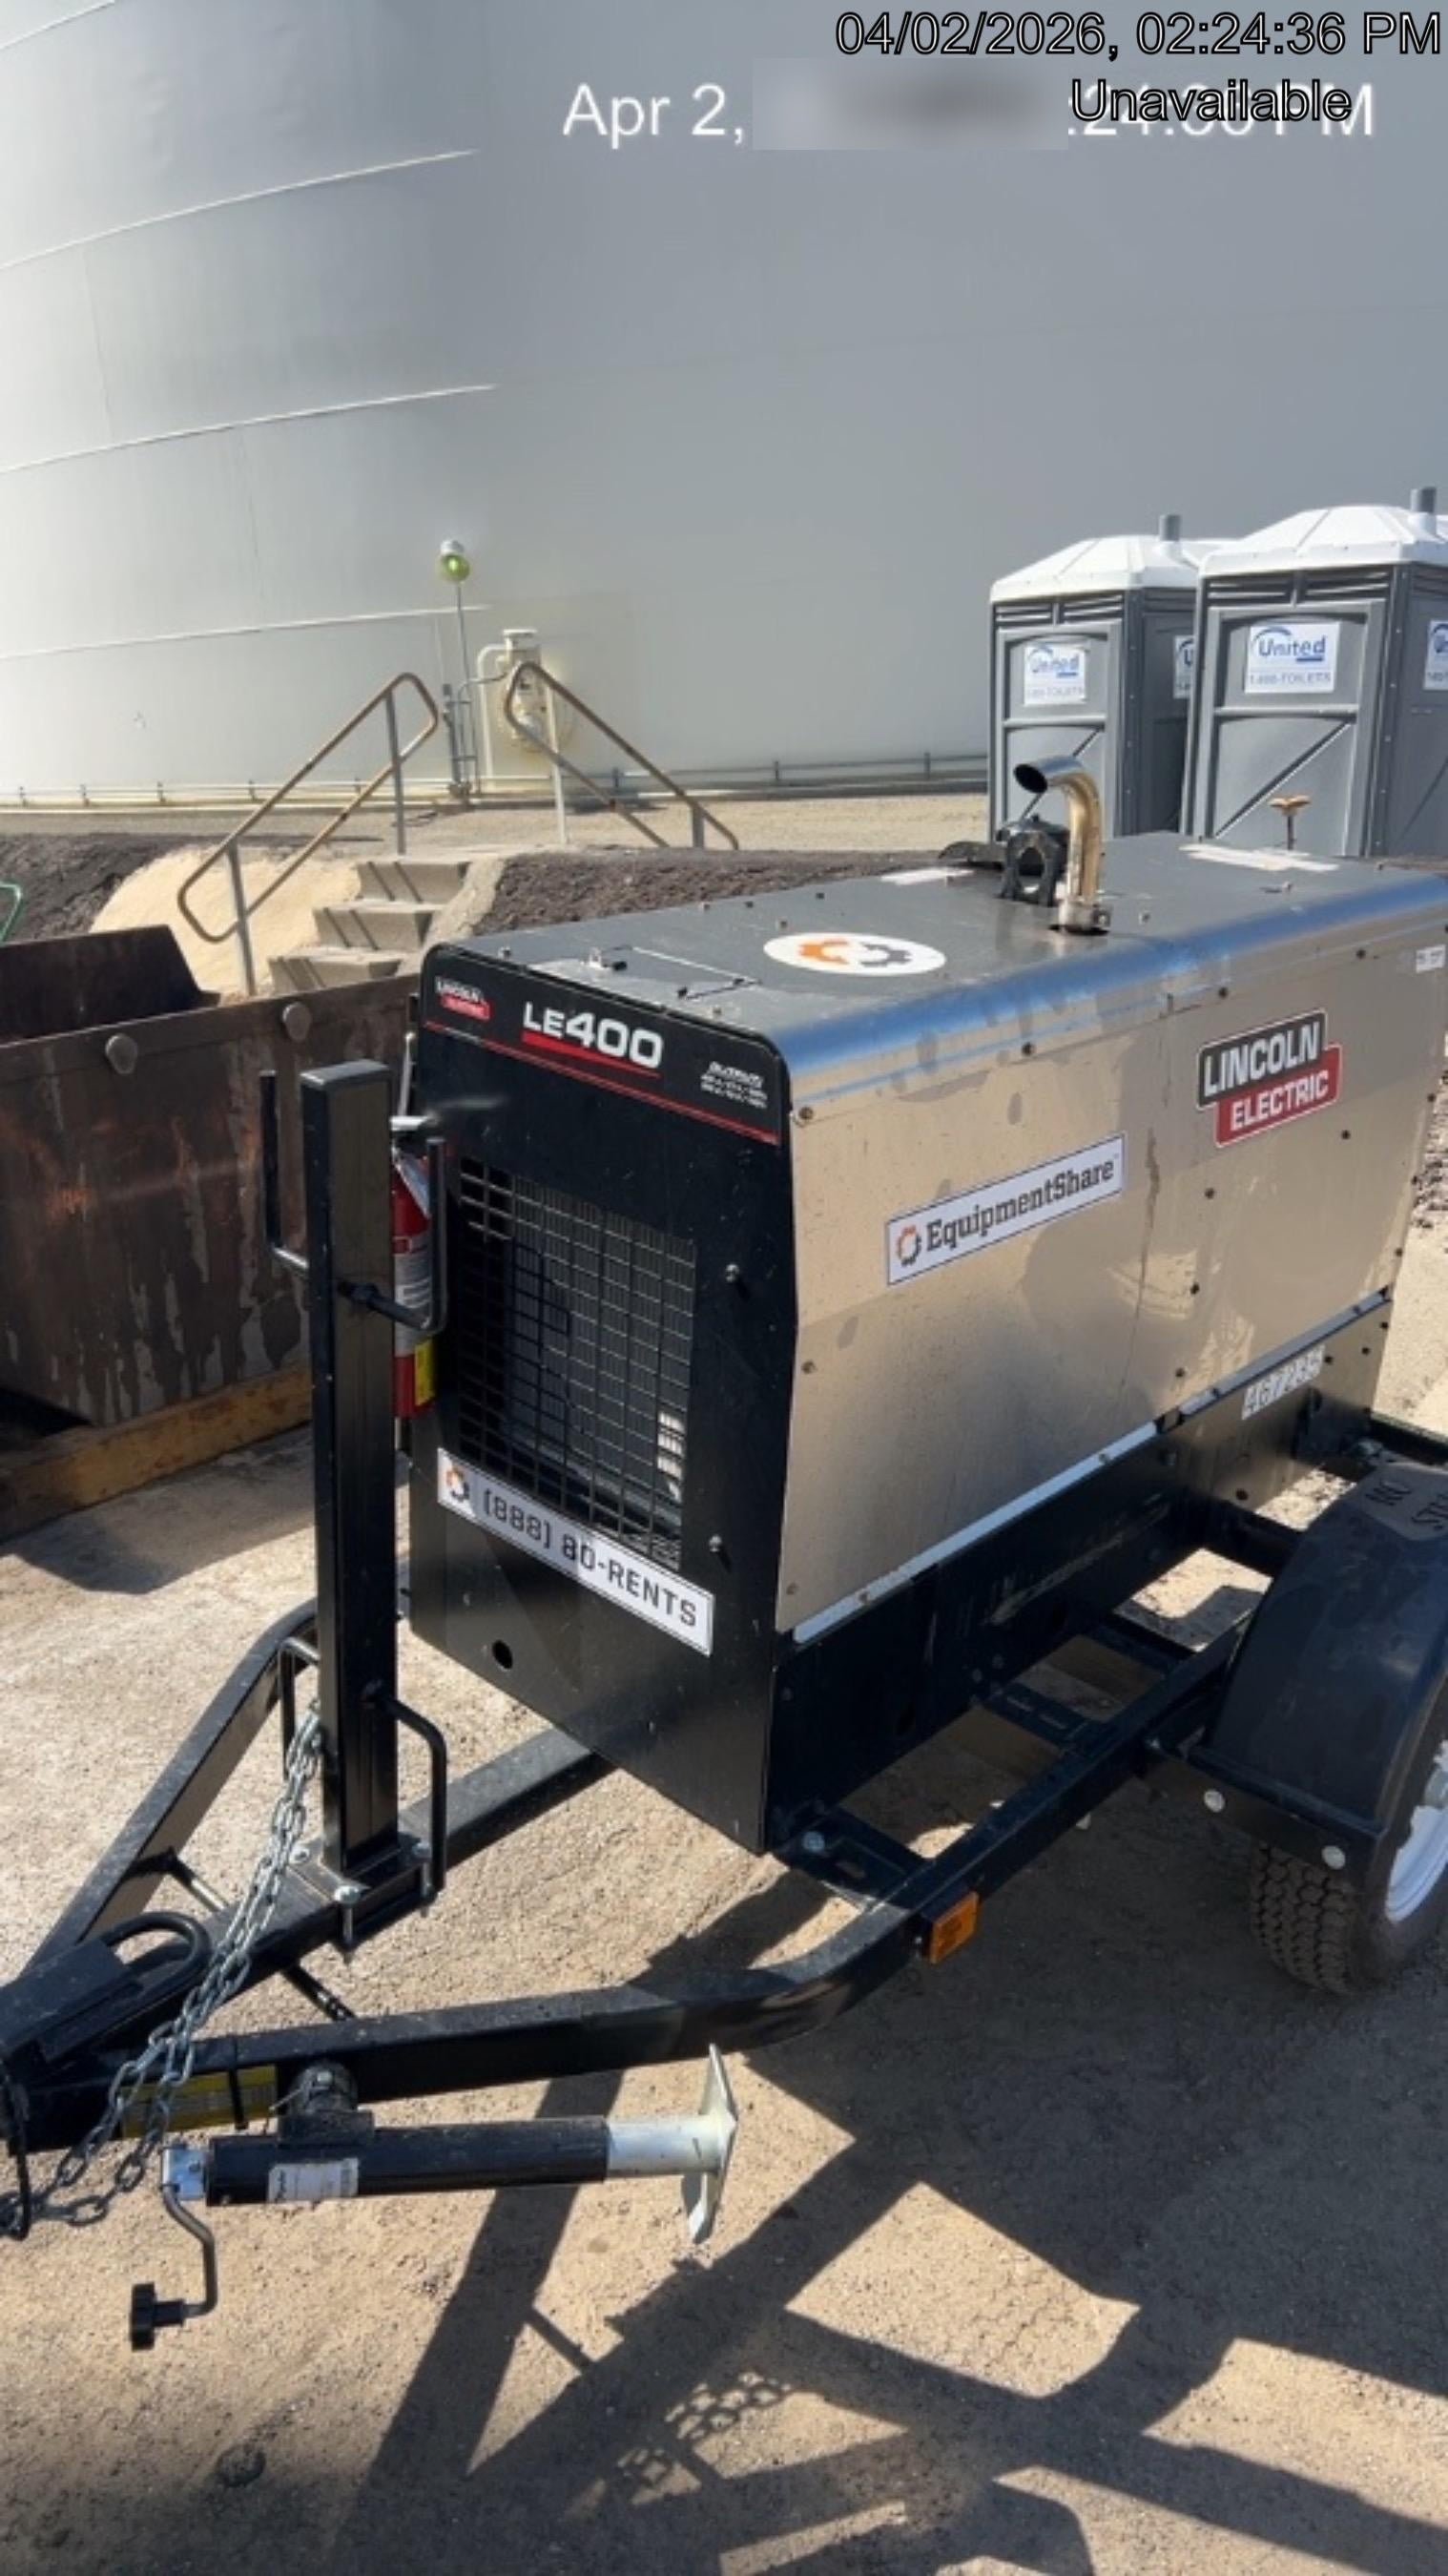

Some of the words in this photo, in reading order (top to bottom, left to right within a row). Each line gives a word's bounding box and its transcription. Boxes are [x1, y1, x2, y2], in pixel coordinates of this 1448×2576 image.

[522, 1000, 664, 1070] LE400
[1204, 1021, 1320, 1097] LINCOLN
[1230, 1070, 1330, 1132] ELECTRIC
[925, 1159, 1114, 1251] EquipmentShare
[562, 1532, 697, 1628] 80-RENTS
